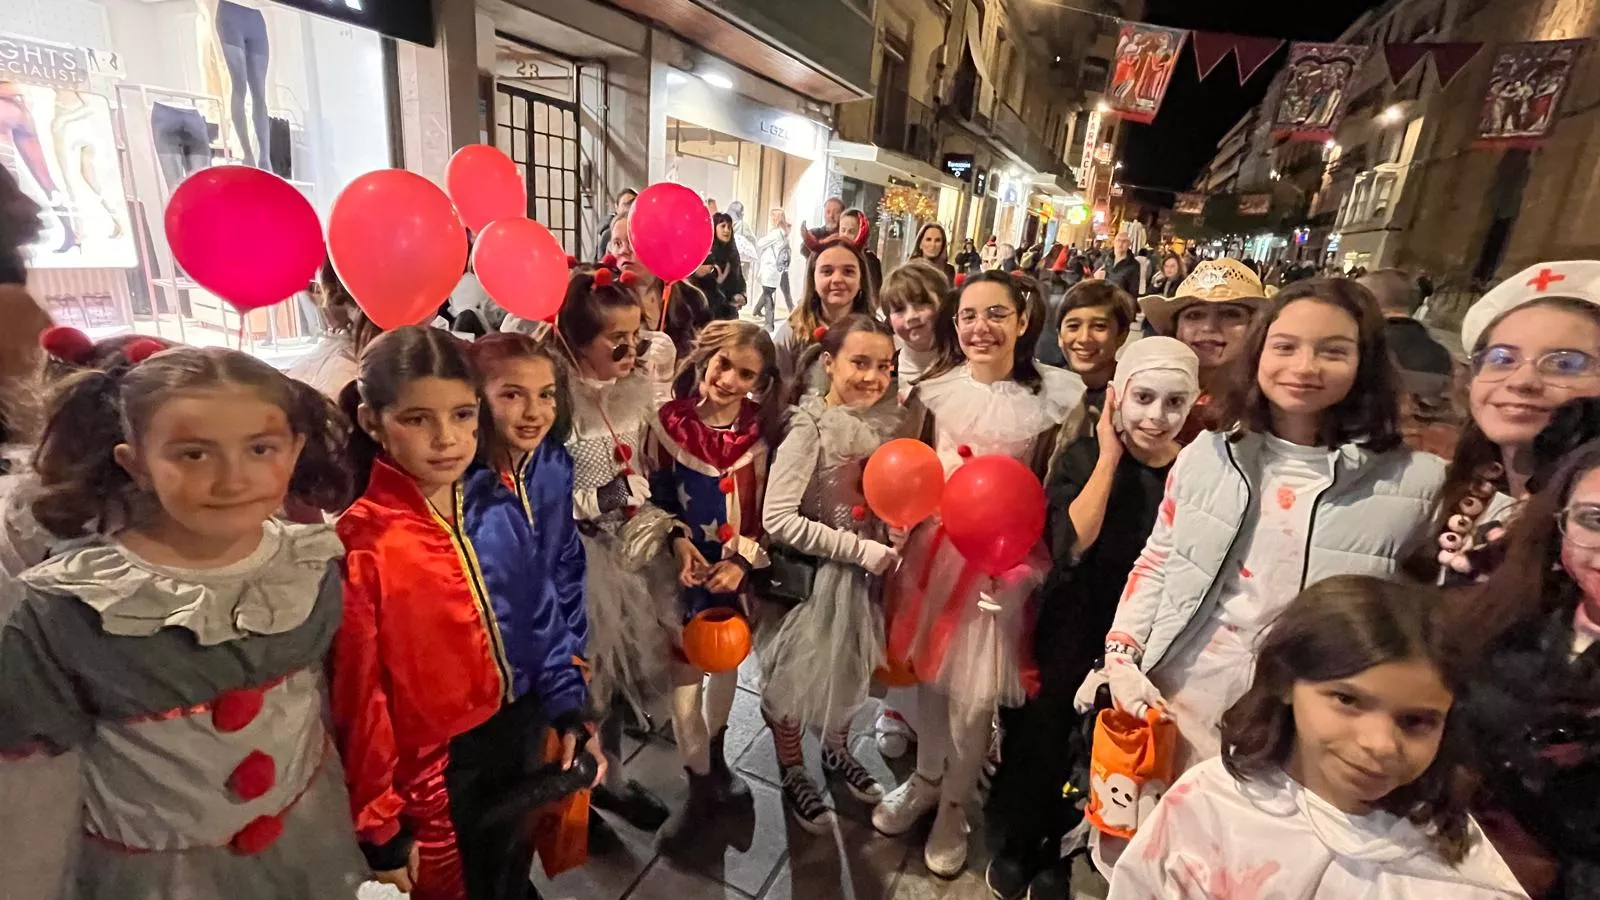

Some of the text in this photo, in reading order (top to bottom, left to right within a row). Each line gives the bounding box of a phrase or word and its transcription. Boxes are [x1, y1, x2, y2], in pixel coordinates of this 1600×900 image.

[0, 40, 77, 70] GHTS
[516, 60, 539, 79] 23
[1080, 113, 1096, 187] FARMACIA
